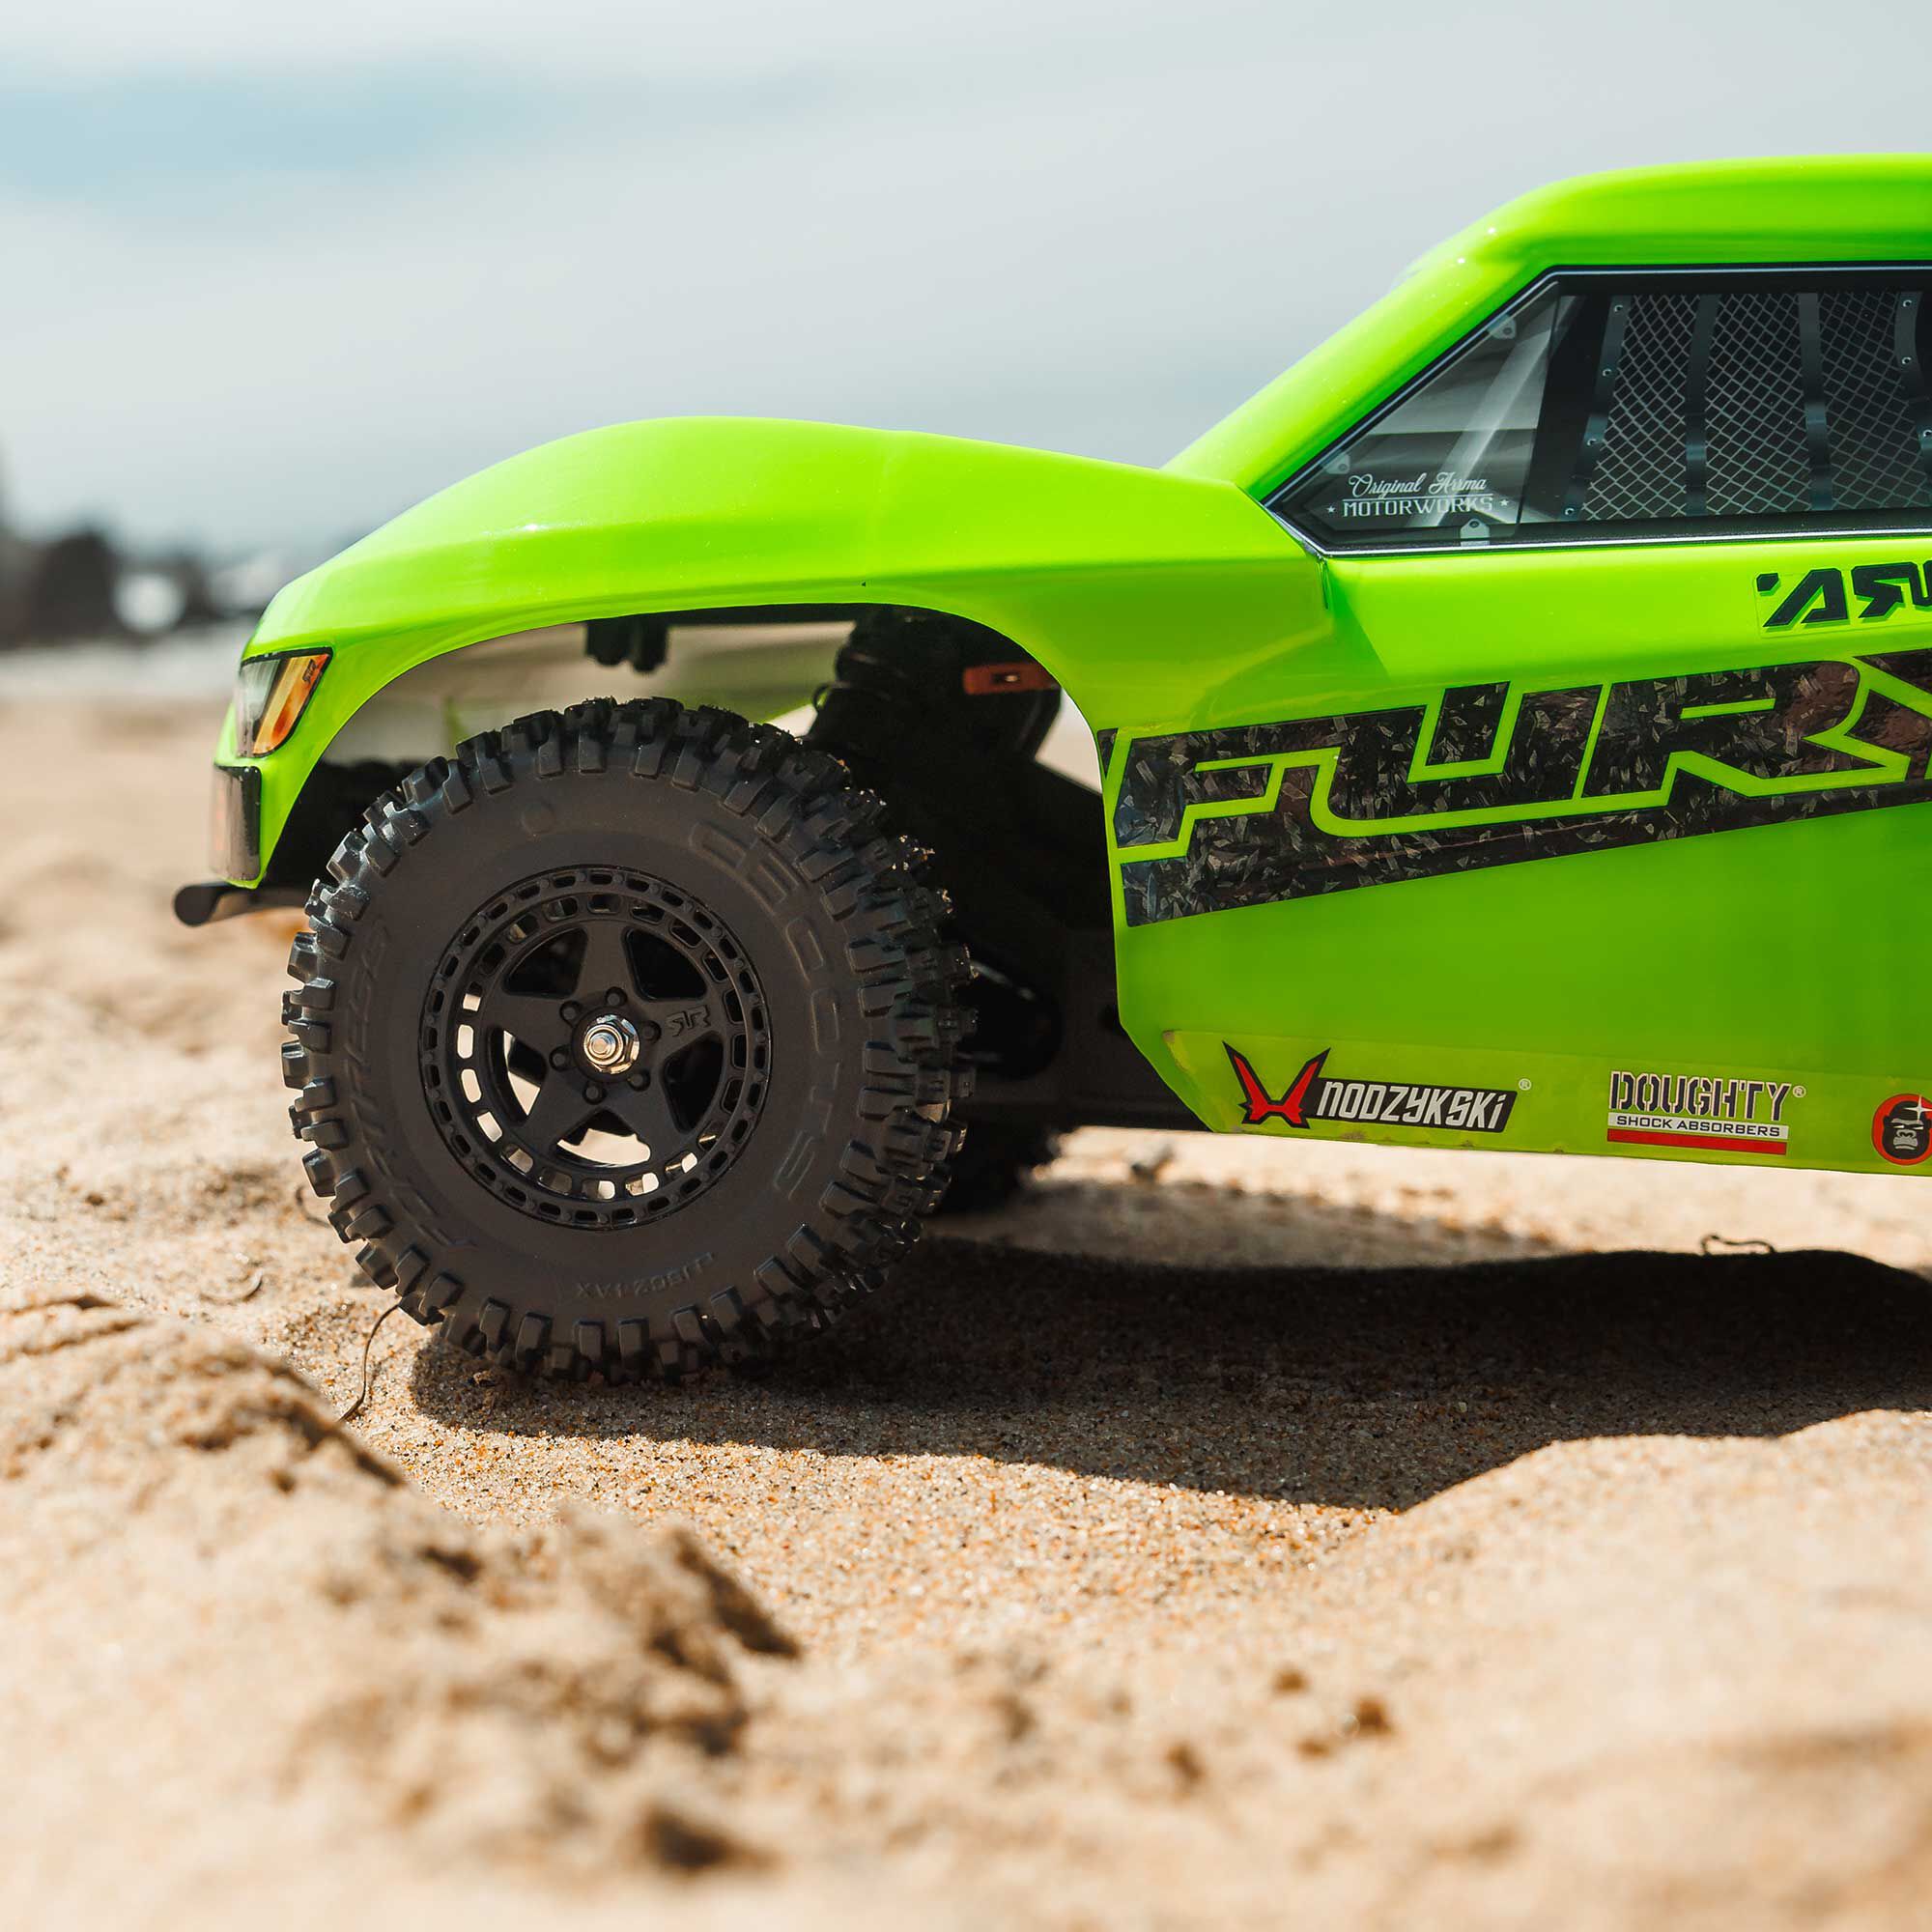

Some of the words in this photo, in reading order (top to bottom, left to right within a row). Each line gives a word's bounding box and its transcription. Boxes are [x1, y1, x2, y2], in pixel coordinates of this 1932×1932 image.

[1349, 472, 1428, 498] Original
[1342, 497, 1493, 517] MOTORWORKS
[1608, 1070, 1792, 1122] DOUGHTY
[1615, 1115, 1673, 1130] SHOCK
[1676, 1120, 1780, 1137] ABSORBERS
